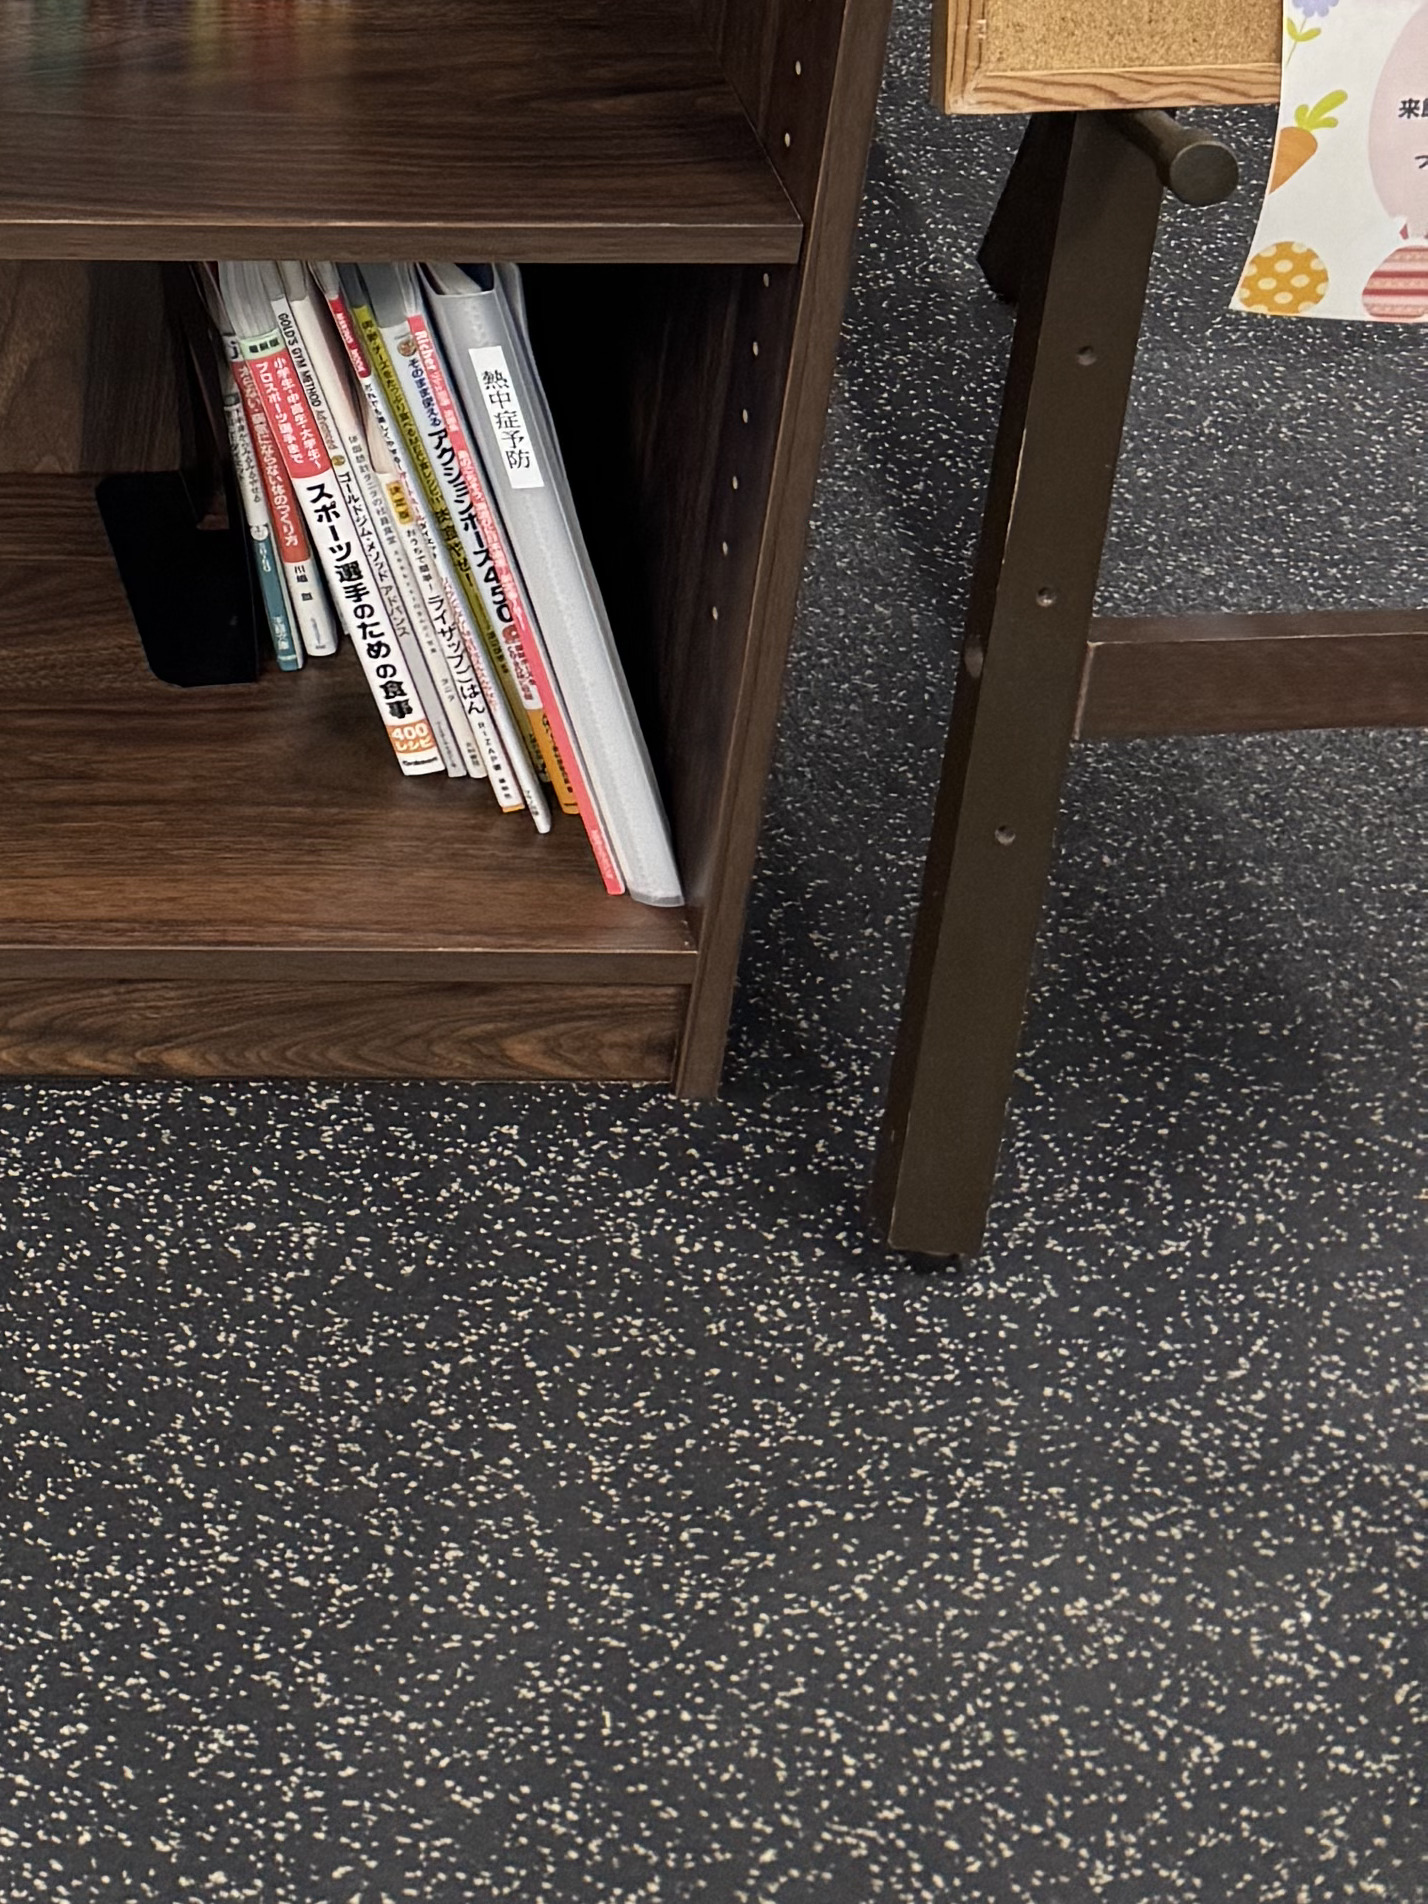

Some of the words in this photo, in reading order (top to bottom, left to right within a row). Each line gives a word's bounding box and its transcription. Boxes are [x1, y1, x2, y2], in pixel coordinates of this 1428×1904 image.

[481, 370, 531, 470] 熱中症予防
[307, 482, 414, 720] スポーツ選手のための食事
[392, 724, 428, 742] 400
[394, 738, 431, 753] レシピ
